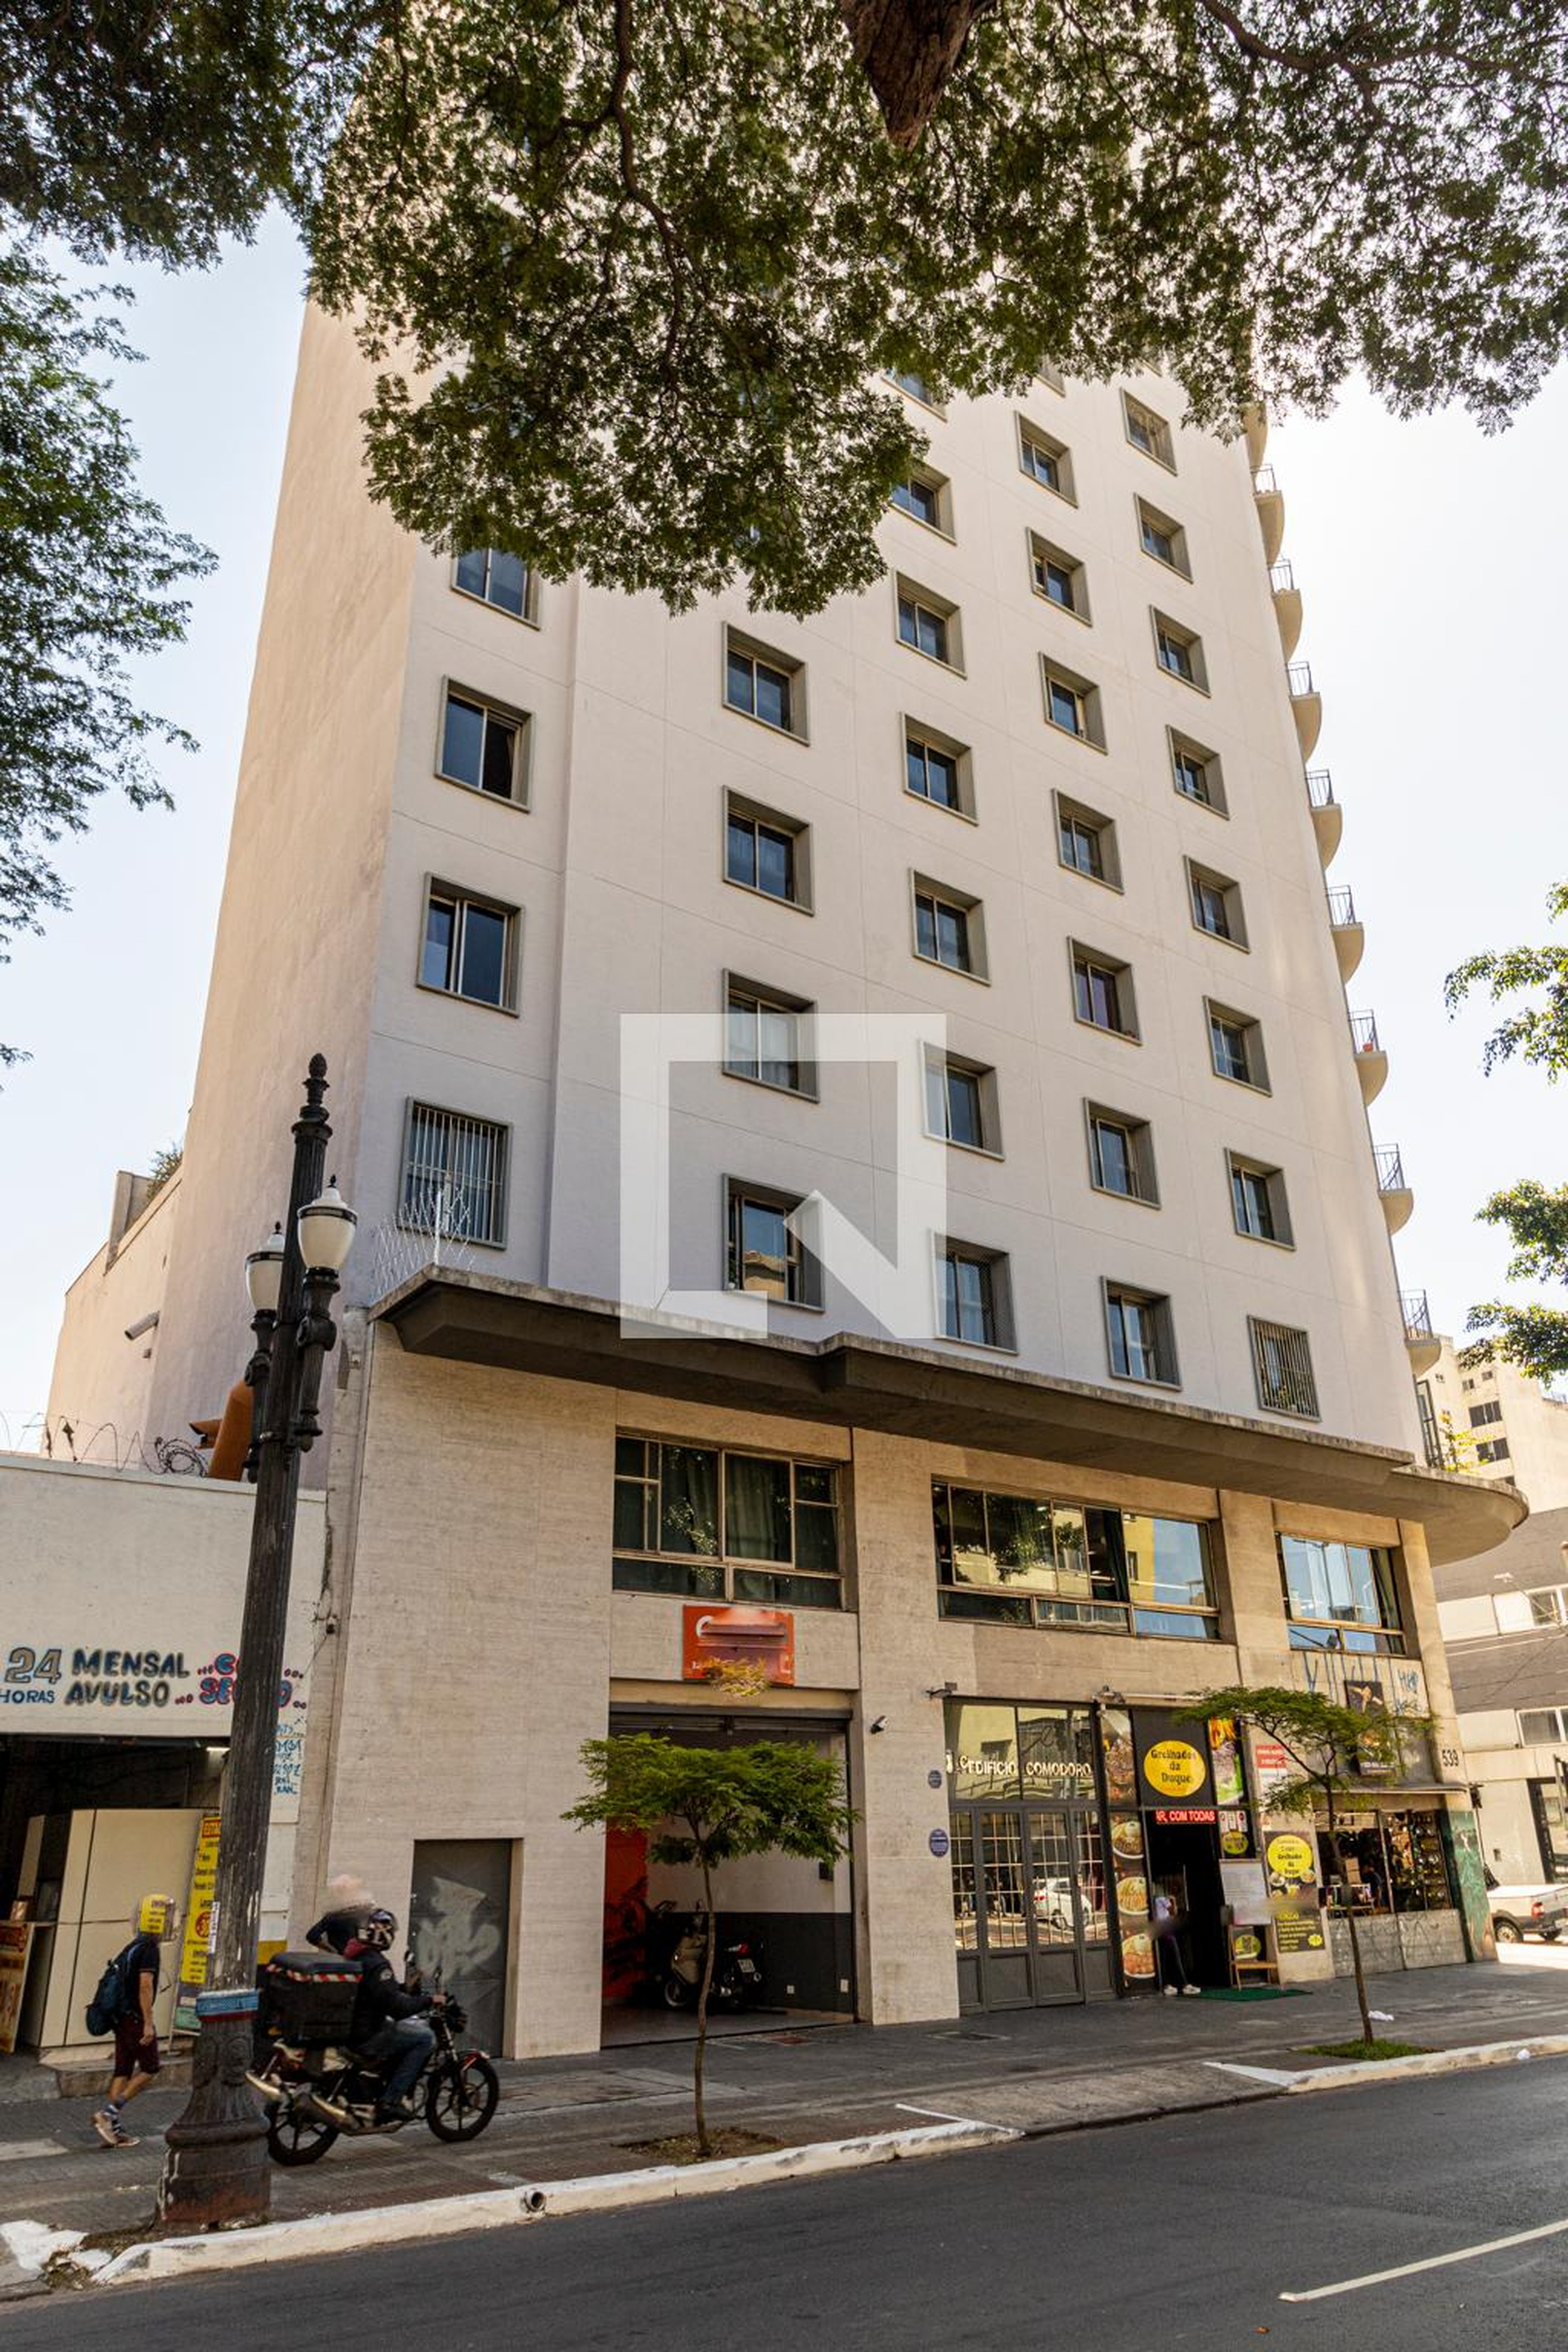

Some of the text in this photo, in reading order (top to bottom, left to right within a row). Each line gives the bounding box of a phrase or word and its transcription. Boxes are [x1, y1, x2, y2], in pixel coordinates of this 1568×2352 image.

[4, 1647, 62, 1684] 24
[71, 1648, 190, 1678] MENSAL
[64, 1680, 170, 1707] AVULSO
[1442, 1749, 1459, 1766] 539
[1025, 1762, 1091, 1776] COMODORO
